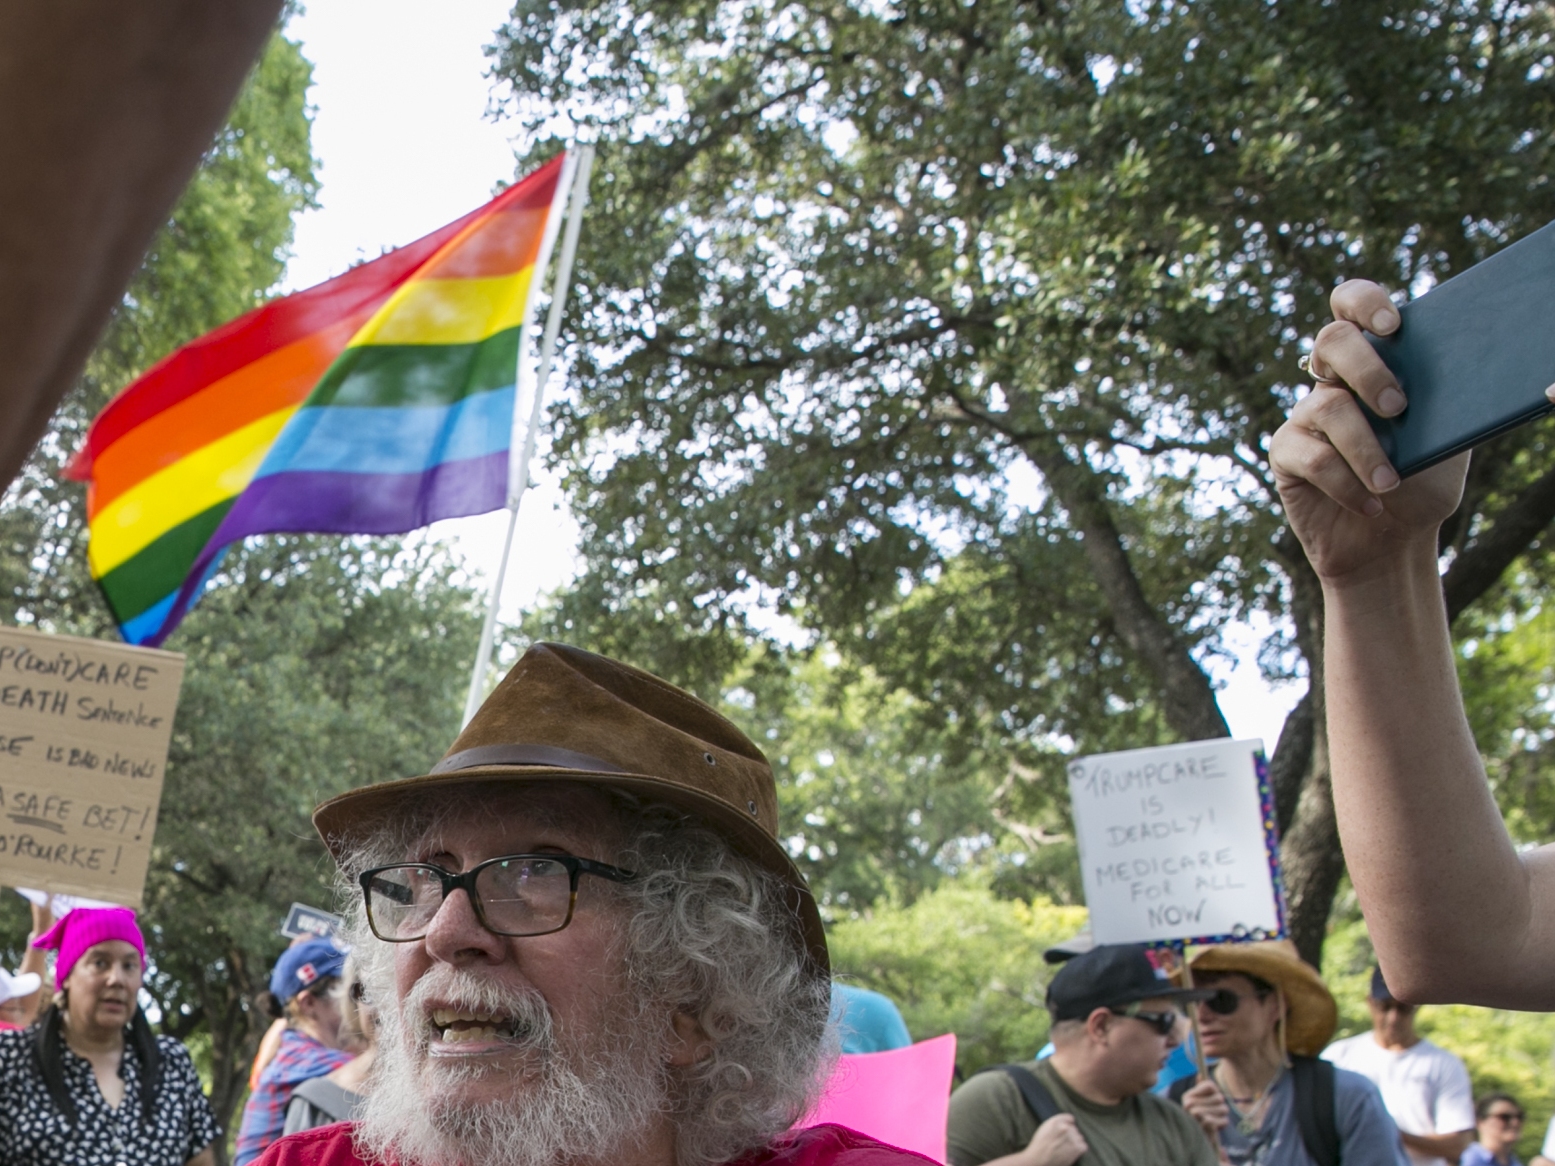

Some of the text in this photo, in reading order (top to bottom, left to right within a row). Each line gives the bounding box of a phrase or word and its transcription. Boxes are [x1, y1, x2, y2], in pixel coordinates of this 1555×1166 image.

[46, 745, 63, 763] IS
[104, 751, 156, 779] NEWS
[1085, 755, 1228, 798] TRUMPCARE
[13, 792, 73, 820] SAFE
[1140, 795, 1164, 815] IS
[1095, 847, 1234, 887] MEDICARE
[1130, 873, 1247, 902] FOR ALL
[1147, 899, 1208, 929] NOW
